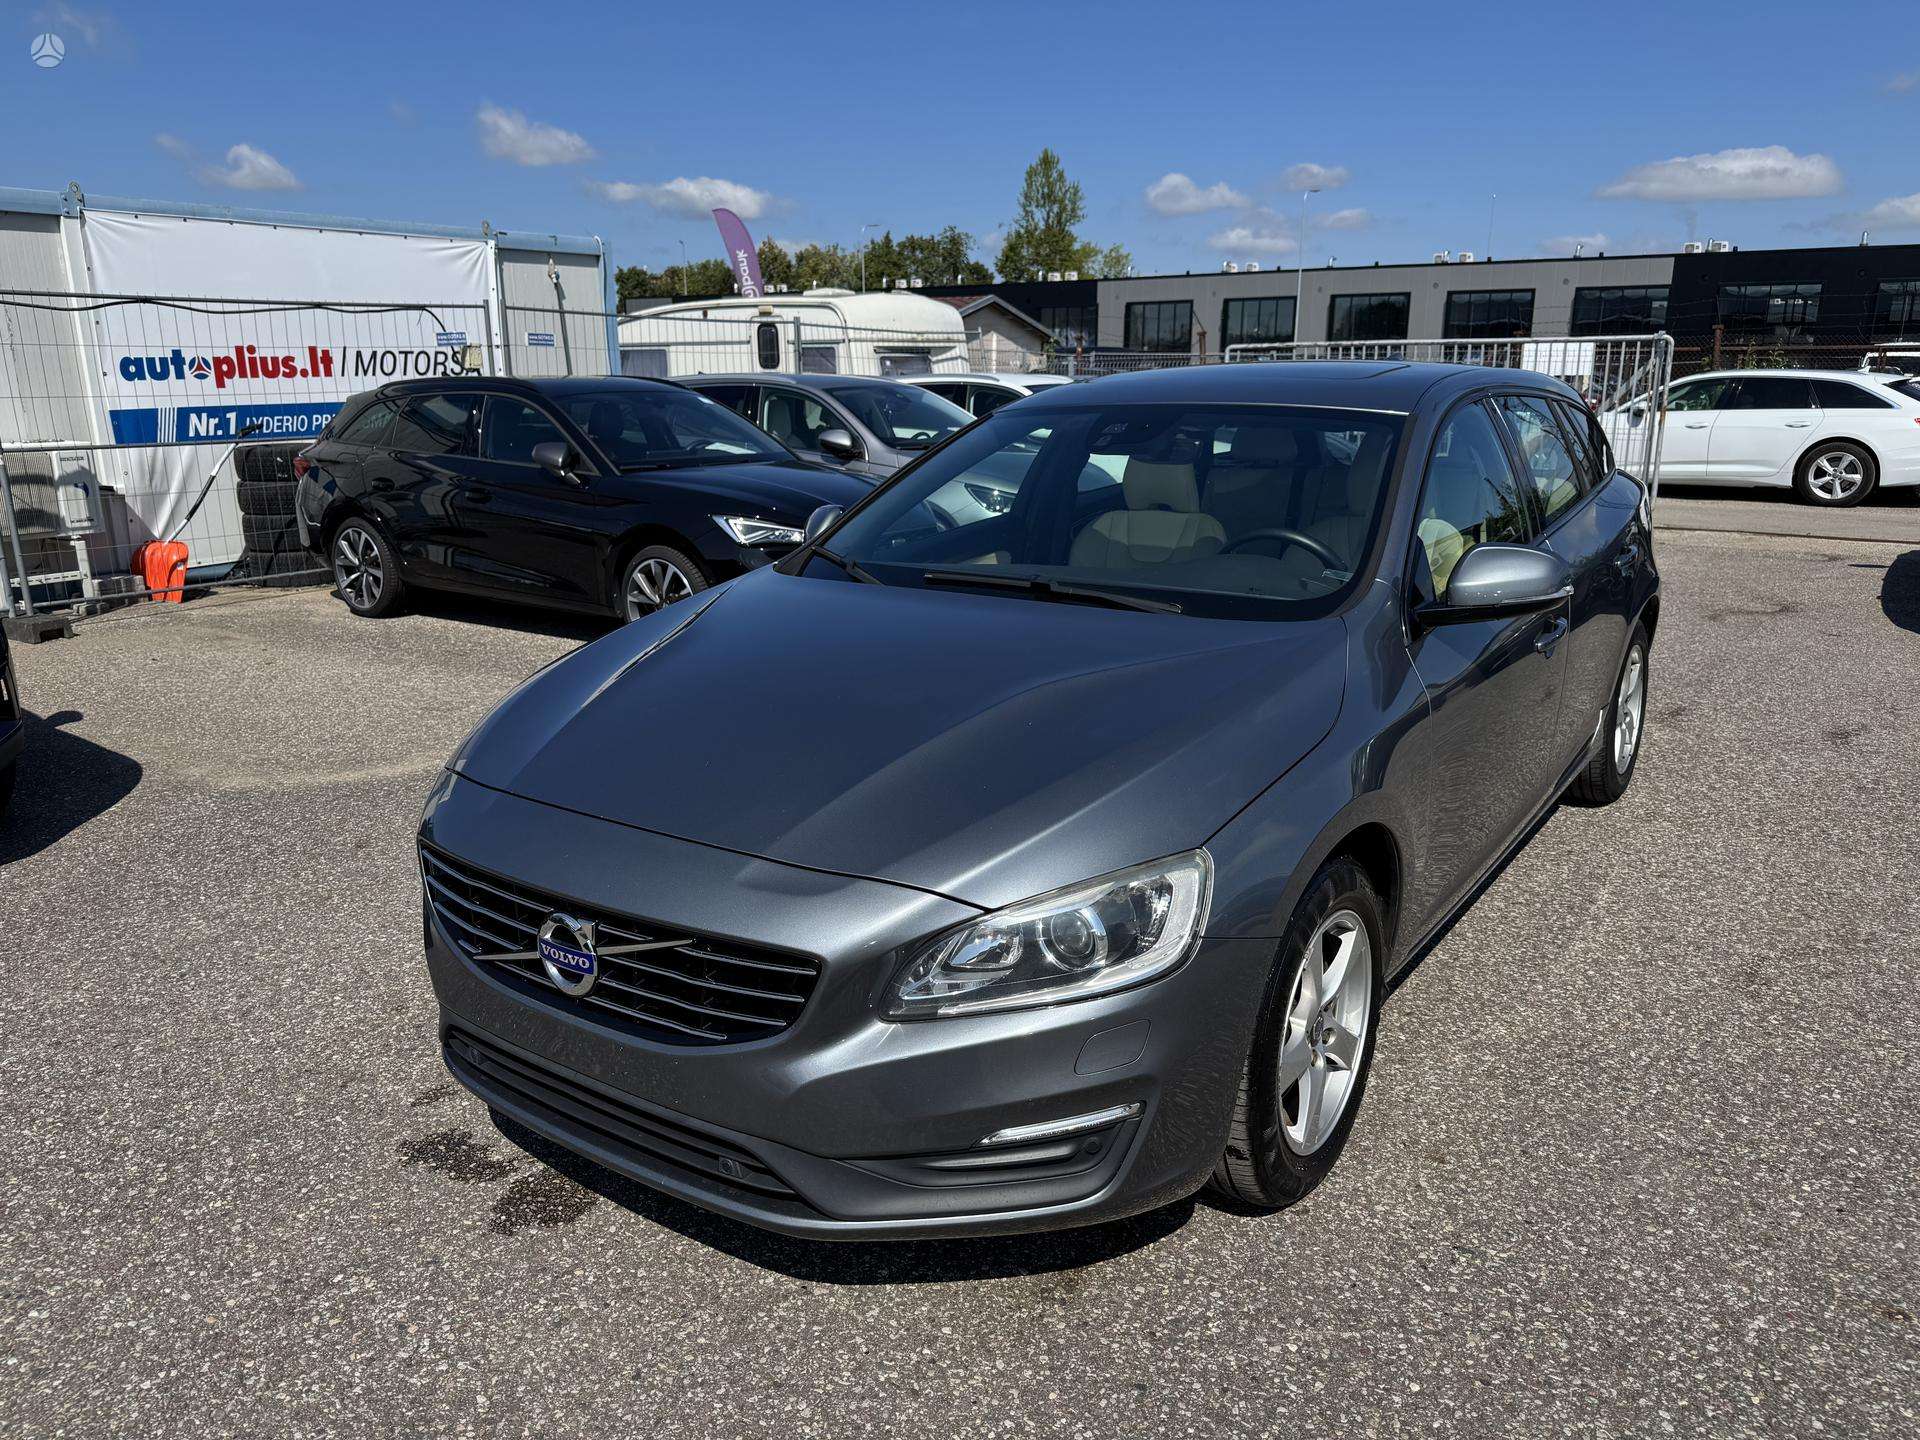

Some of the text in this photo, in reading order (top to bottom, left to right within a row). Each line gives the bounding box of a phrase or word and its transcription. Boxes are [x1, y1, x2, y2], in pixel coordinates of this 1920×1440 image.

[119, 345, 482, 388] autoplius.lt MOTORS
[312, 413, 336, 432] PR
[540, 942, 590, 969] VOLVO
